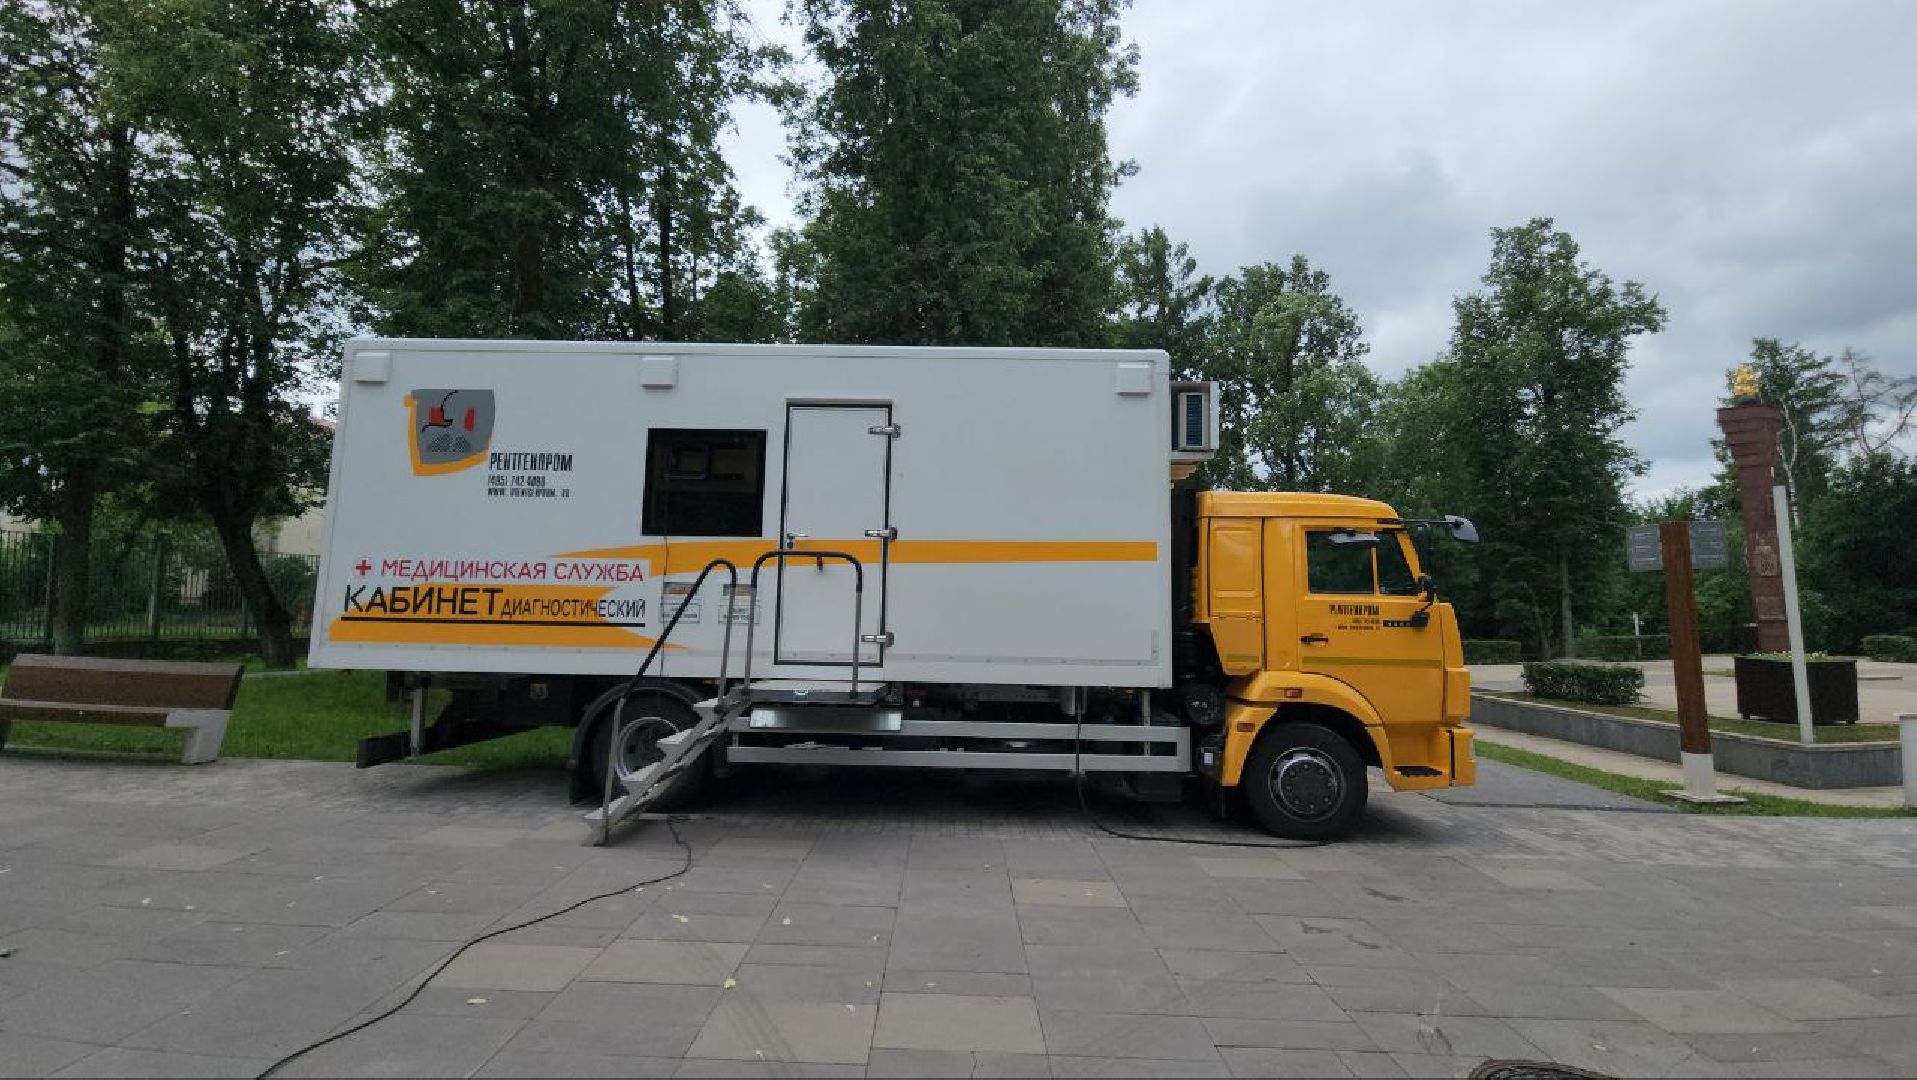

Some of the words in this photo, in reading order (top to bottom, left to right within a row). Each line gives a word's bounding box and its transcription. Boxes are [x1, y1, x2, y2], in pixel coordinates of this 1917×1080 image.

[381, 559, 547, 582] МЕДИЦИНСКАЯ
[554, 562, 644, 582] СЛУЖБА
[344, 584, 504, 615] КАБИНЕТ
[501, 598, 646, 619] ДИАГНОСТИЧЕСКИЙ
